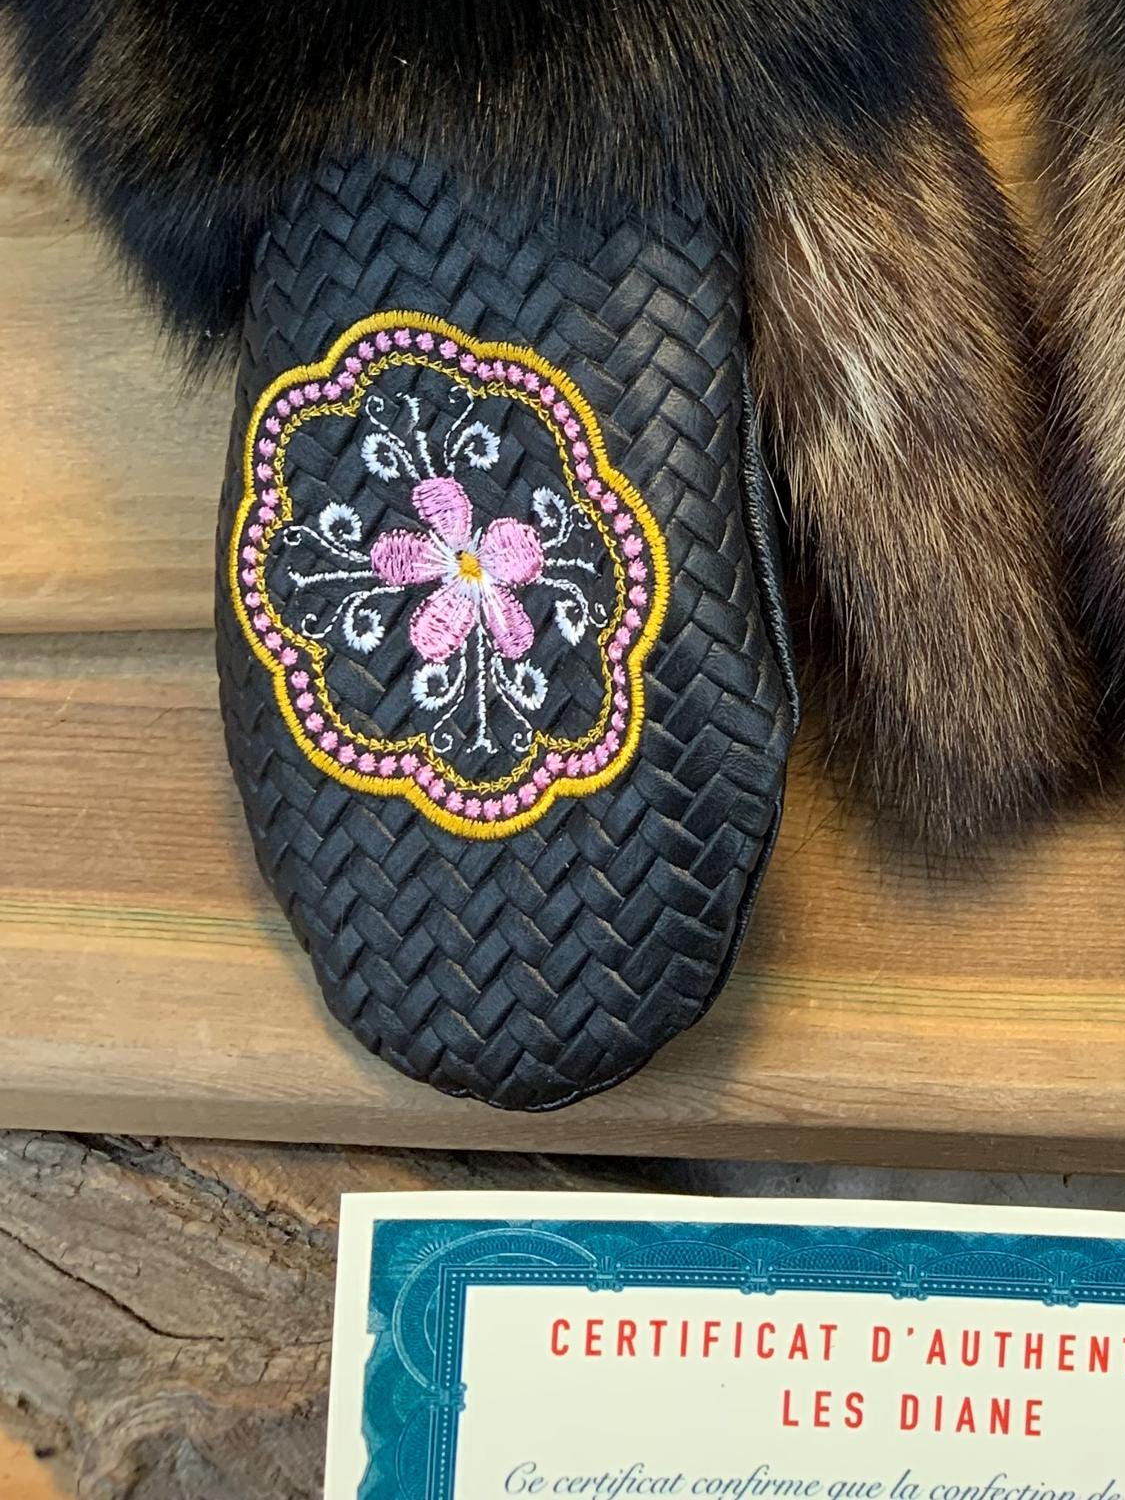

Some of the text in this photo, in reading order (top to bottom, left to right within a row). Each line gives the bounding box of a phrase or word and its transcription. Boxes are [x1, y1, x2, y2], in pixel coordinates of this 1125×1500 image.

[550, 1318, 838, 1361] CERTIFICAT
[782, 1389, 1043, 1437] LES DIANE
[504, 1461, 548, 1496] Ce
[552, 1462, 686, 1500] certificat
[690, 1464, 824, 1500] confirme
[826, 1481, 884, 1500] que
[889, 1469, 921, 1500] la
